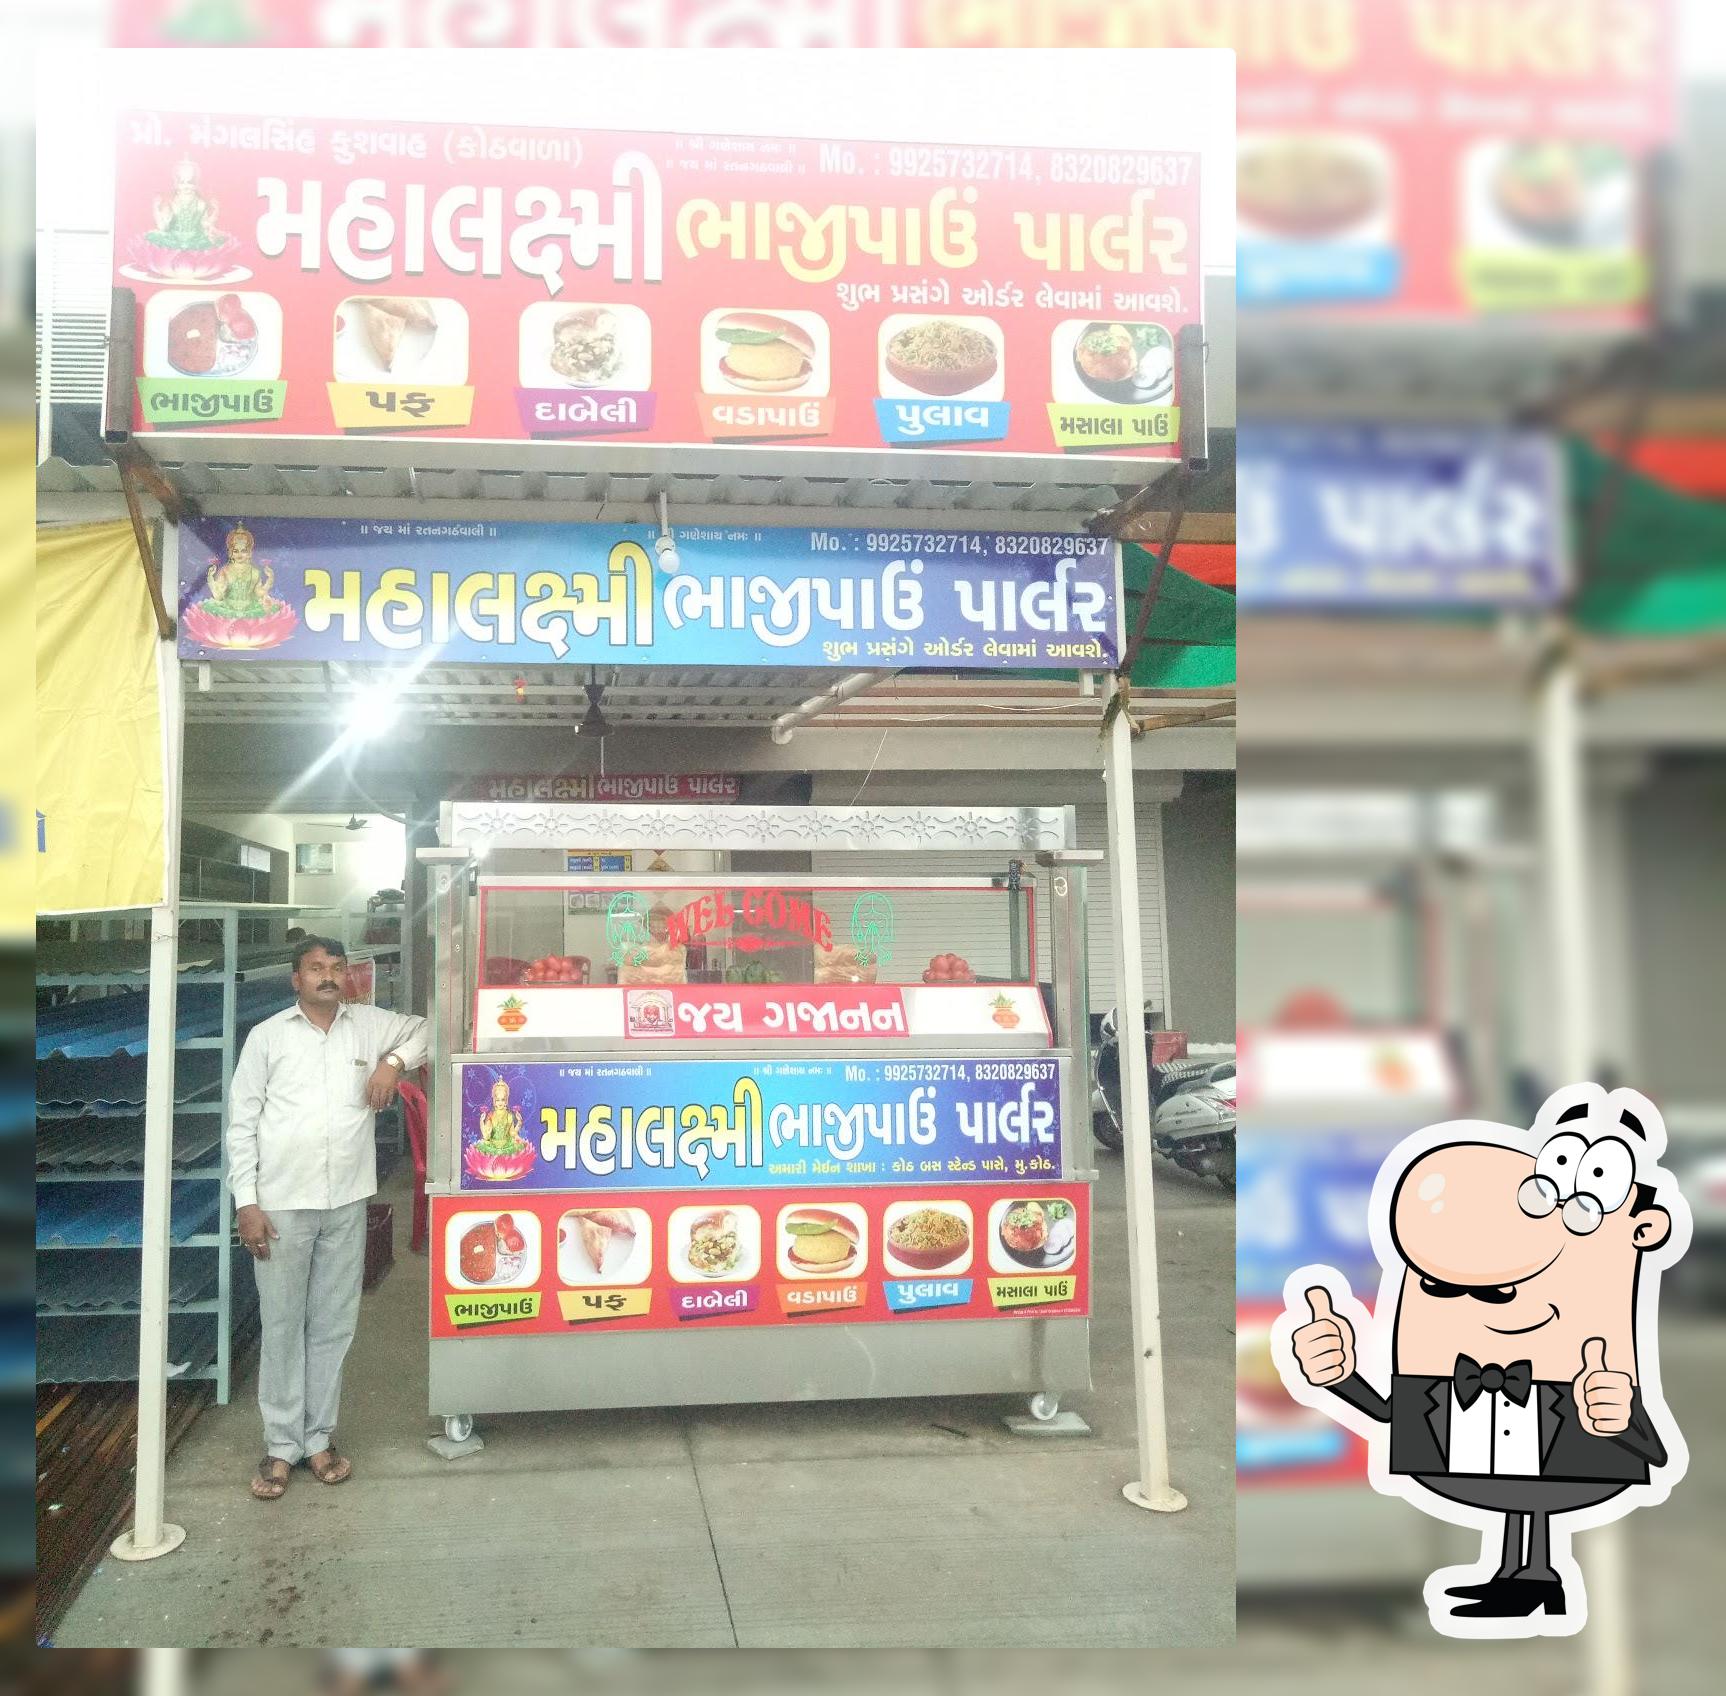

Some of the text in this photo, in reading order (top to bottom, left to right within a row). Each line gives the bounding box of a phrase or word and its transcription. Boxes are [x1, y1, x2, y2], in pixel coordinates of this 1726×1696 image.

[819, 143, 864, 176] Mo.
[888, 145, 1041, 185] 9925732714,
[1050, 151, 1193, 187] 8320829637
[254, 149, 1190, 297] મહાલક્ષ્મી ભાજીપાઉં પાર્લર
[836, 279, 1189, 313] શુભ પ્રસંગે ઓર્ડર લેવામાં આવશે.
[150, 387, 275, 418] ભાજીપાઉં
[365, 390, 435, 418] પફ
[534, 396, 638, 424] દાબેલી
[711, 402, 821, 428] વડાપાઉં
[895, 404, 990, 436] પુલાવ
[1059, 413, 1169, 438] મસાલા પાઉં
[372, 524, 393, 535] જય
[810, 532, 847, 551] Mo.
[866, 532, 988, 557] 9925732714,
[995, 536, 1109, 556] 8320829637
[303, 540, 1107, 660] મહાલક્ષ્મી ભાજીપાઉં પાર્લર
[822, 637, 1108, 661] શુભ પ્રસંગે ઓર્ડર લેવામાં આવશે.
[677, 1000, 905, 1033] જય ગજાનન
[845, 1066, 871, 1082] Mo.
[884, 1064, 971, 1083] 9925732714,
[974, 1063, 1056, 1081] 8320829637
[540, 1075, 1055, 1182] મહાલક્ષ્મી ભાજીપાઉં પાર્લર
[891, 1156, 915, 1173] કોઠ
[919, 1160, 942, 1173] બસ
[947, 1156, 977, 1172] સ્ટેન્ડ
[581, 1294, 628, 1311] પફ
[680, 1290, 748, 1310] દાબેલી
[786, 1285, 858, 1305] વડાપાઉં
[897, 1280, 960, 1304] પુલાવ
[996, 1281, 1069, 1299] મસાલા પાઉં
[454, 1298, 533, 1320] ભાજીપાઉં
